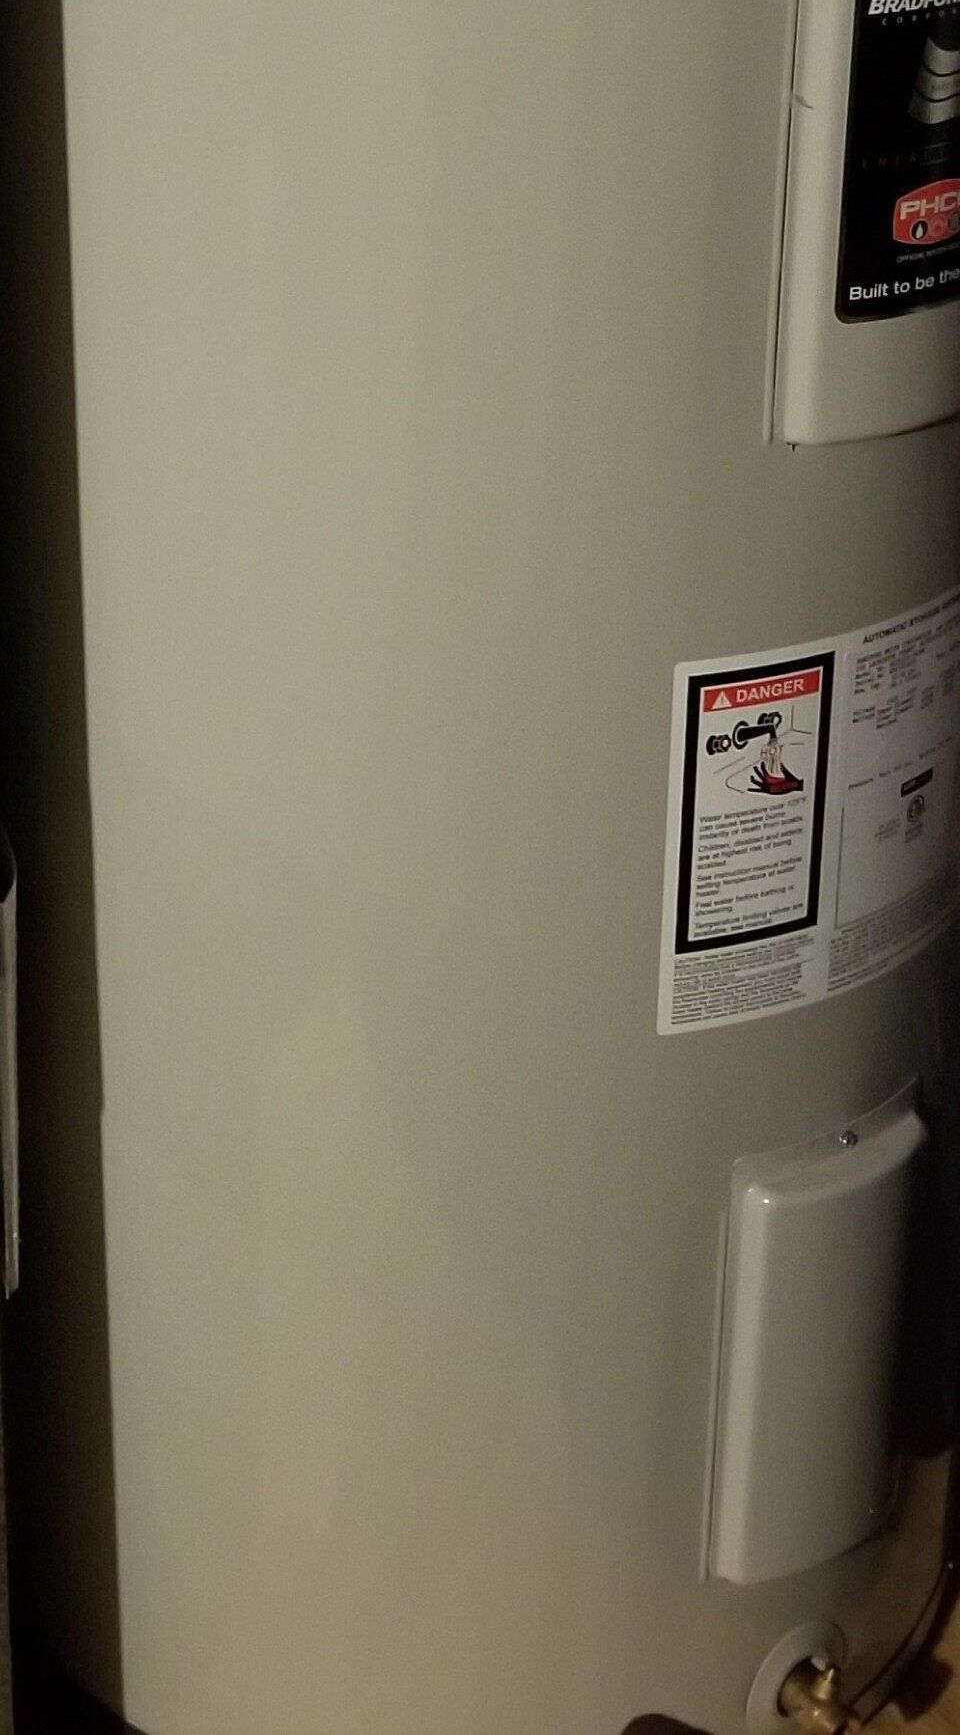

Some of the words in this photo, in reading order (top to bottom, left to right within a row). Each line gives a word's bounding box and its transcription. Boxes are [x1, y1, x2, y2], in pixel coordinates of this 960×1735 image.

[899, 191, 960, 220] PHC
[849, 283, 889, 301] Built
[894, 281, 910, 294] to
[915, 276, 934, 290] be
[939, 268, 960, 284] the
[736, 678, 804, 703] DANGER
[761, 745, 784, 756] HOT
